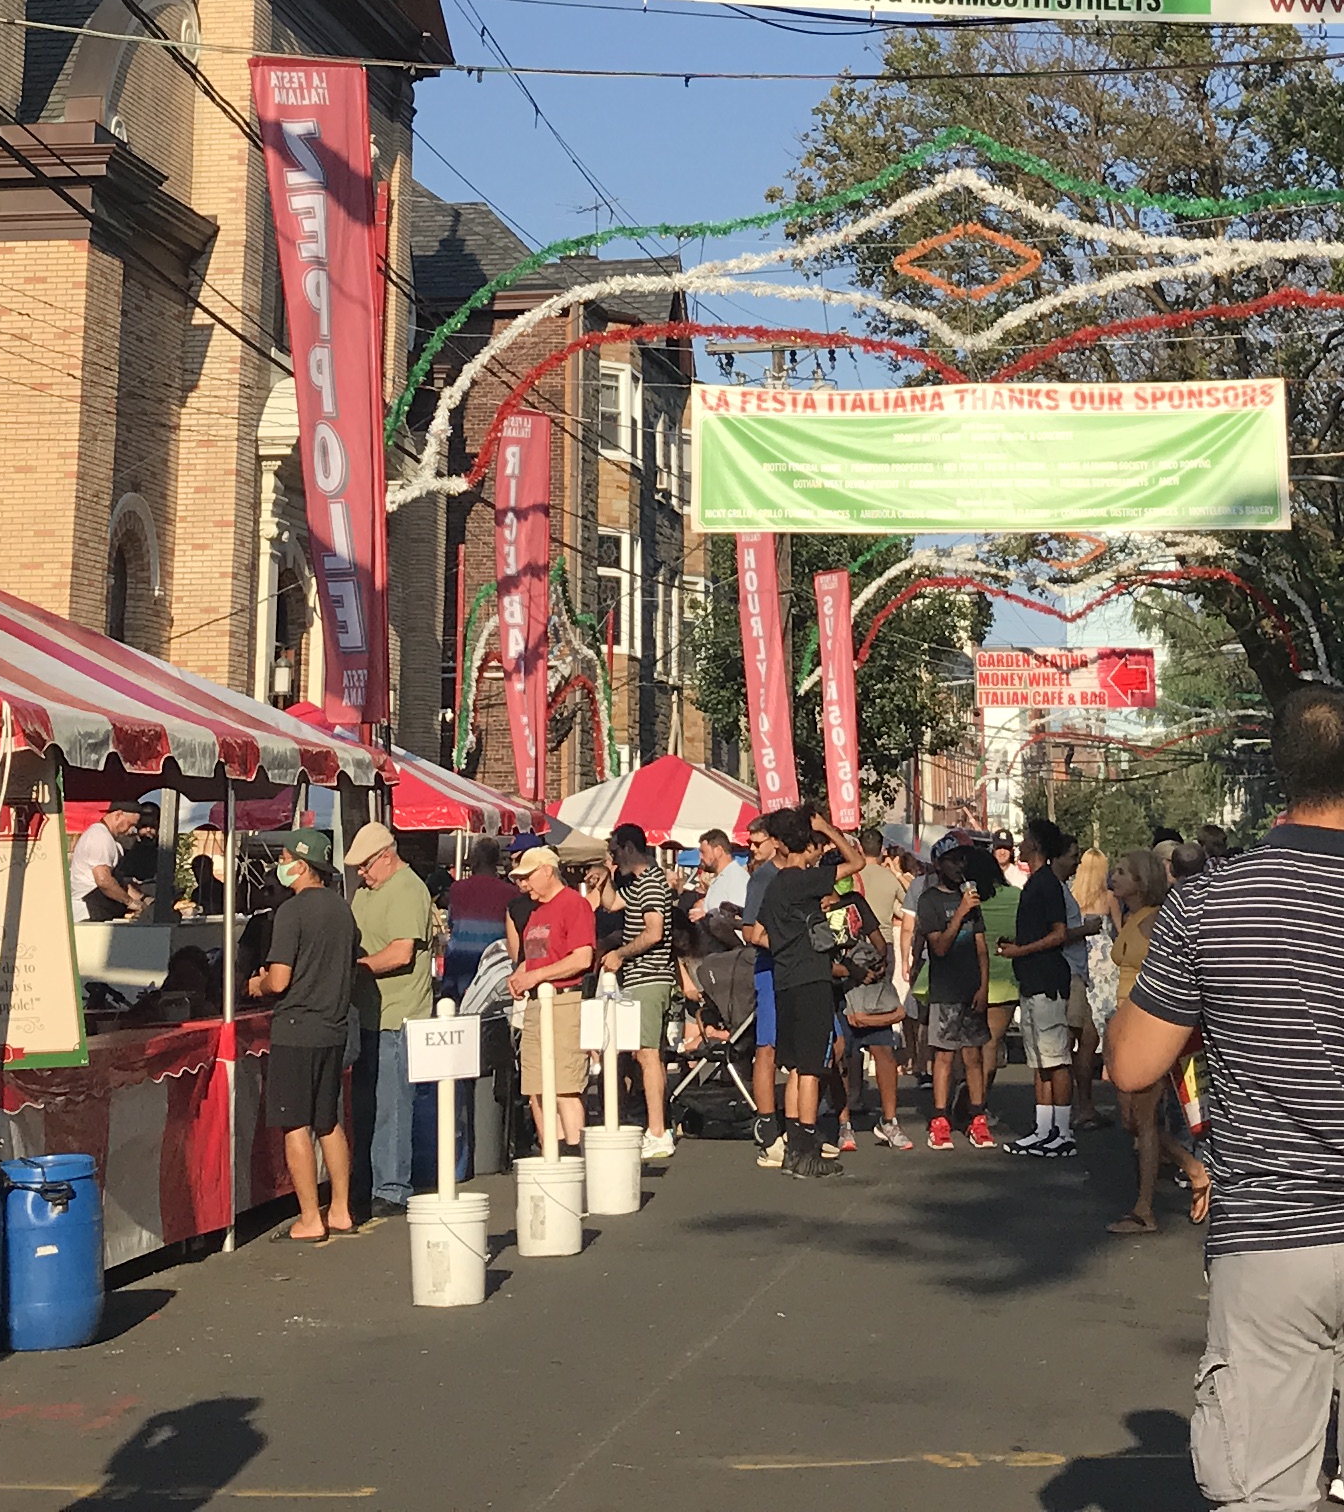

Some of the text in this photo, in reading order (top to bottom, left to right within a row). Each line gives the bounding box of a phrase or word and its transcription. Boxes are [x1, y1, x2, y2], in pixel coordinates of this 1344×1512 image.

[701, 384, 1275, 414] LA FESTA ITALIANA THANKS OUR SPONSORS
[977, 653, 1089, 669] GARDEN SEATING
[978, 672, 1072, 687] MONEY WHEEL
[978, 689, 1108, 706] ITALIAN CAFÉ & BAR
[24, 964, 36, 973] to
[23, 979, 33, 991] is
[425, 1030, 465, 1046] EXIT
